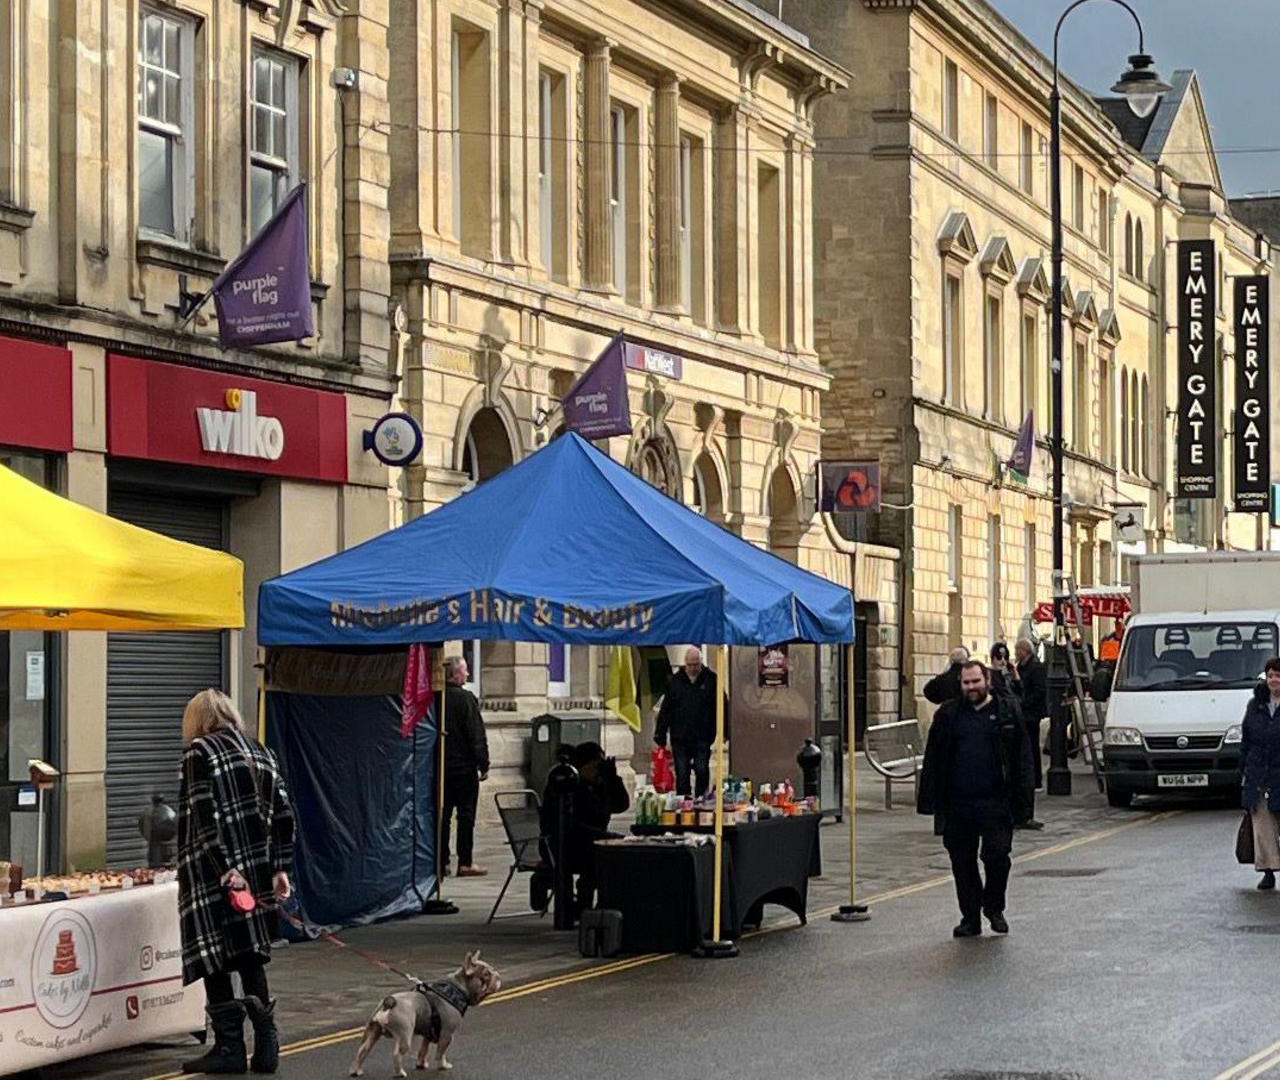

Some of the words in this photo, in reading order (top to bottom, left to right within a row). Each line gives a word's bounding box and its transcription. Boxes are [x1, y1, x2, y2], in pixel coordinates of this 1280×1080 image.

[232, 273, 278, 296] purple
[252, 290, 279, 305] flag
[1185, 251, 1207, 365] EMERY
[1241, 285, 1262, 390] EMERY
[196, 388, 284, 460] wilko
[1187, 374, 1207, 465] GATE
[1242, 398, 1261, 482] GATE
[1180, 475, 1213, 484] SHOPPING
[1184, 483, 1209, 492] CENTRE
[1236, 492, 1267, 500] SHOPPING
[1241, 500, 1263, 508] CENTRE
[471, 587, 525, 623] Hair
[533, 595, 553, 627] &
